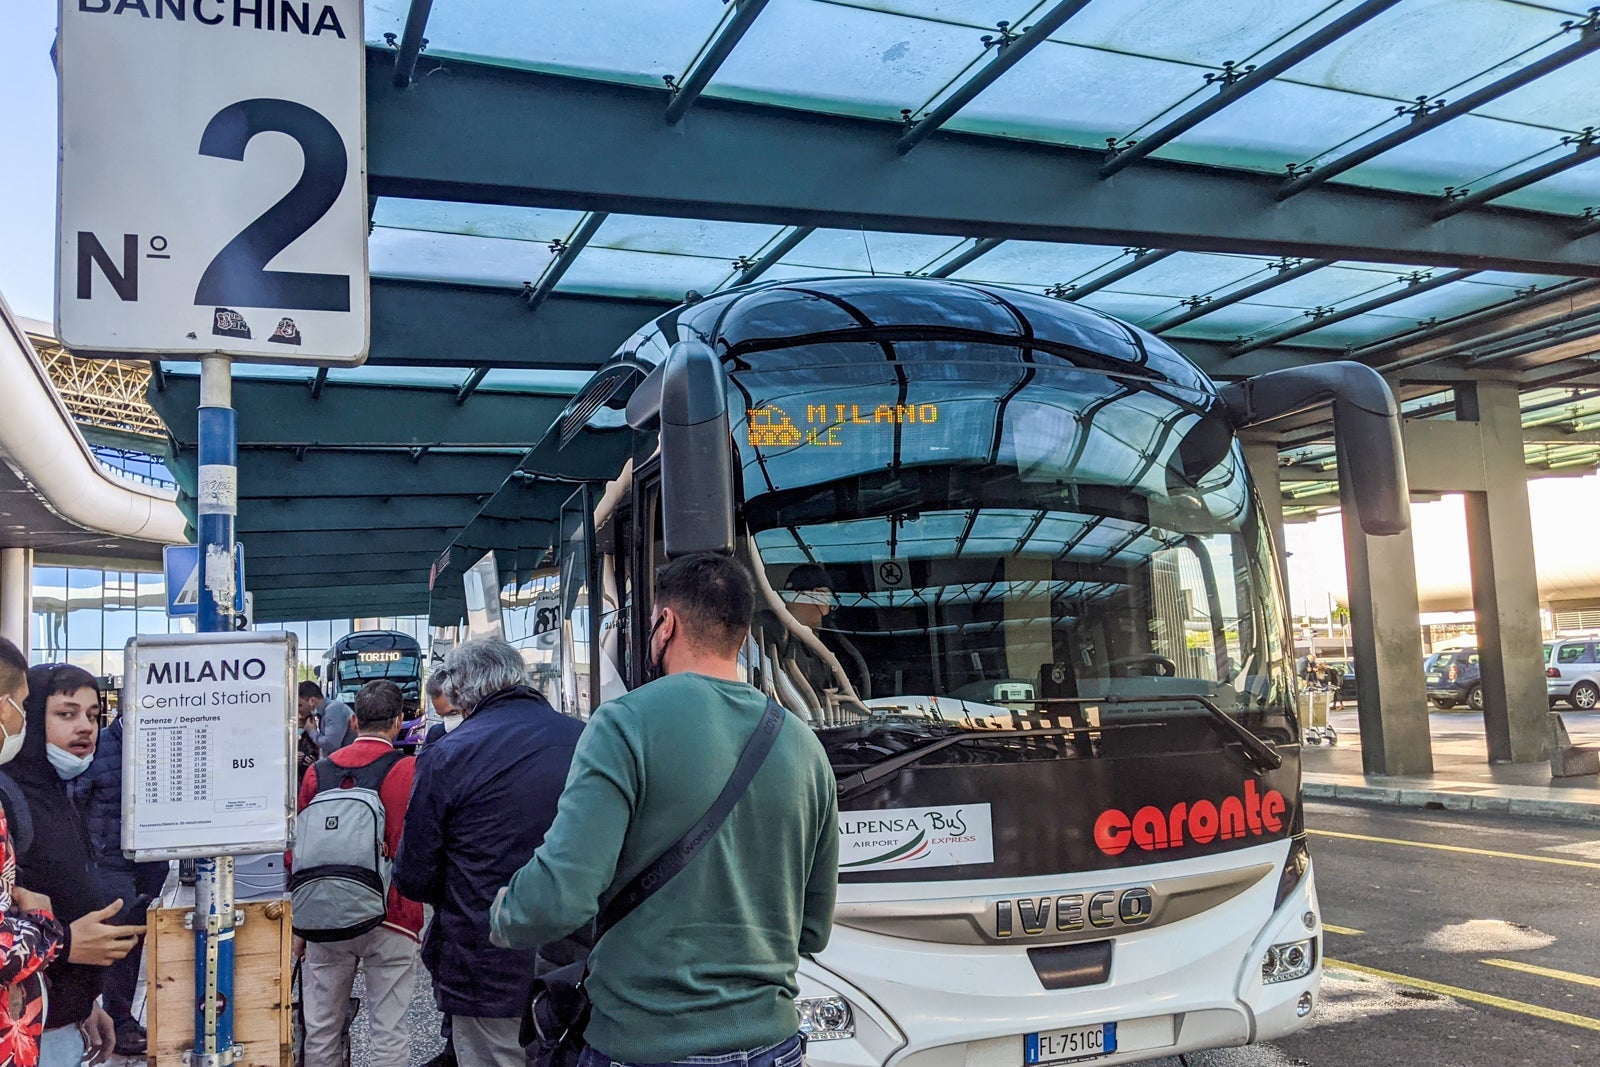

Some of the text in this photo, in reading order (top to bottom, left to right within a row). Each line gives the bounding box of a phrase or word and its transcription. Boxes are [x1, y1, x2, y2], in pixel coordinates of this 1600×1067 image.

[193, 98, 350, 312] 2
[807, 404, 938, 423] MILANO
[359, 651, 400, 662] TORINO
[146, 658, 266, 685] MILANO
[141, 690, 271, 709] Central Station
[180, 716, 220, 724] Departures
[232, 758, 255, 769] BUS
[1094, 779, 1286, 856] caronte
[853, 835, 976, 848] AIRPORT EXPRESS
[996, 887, 1152, 937] IVECO
